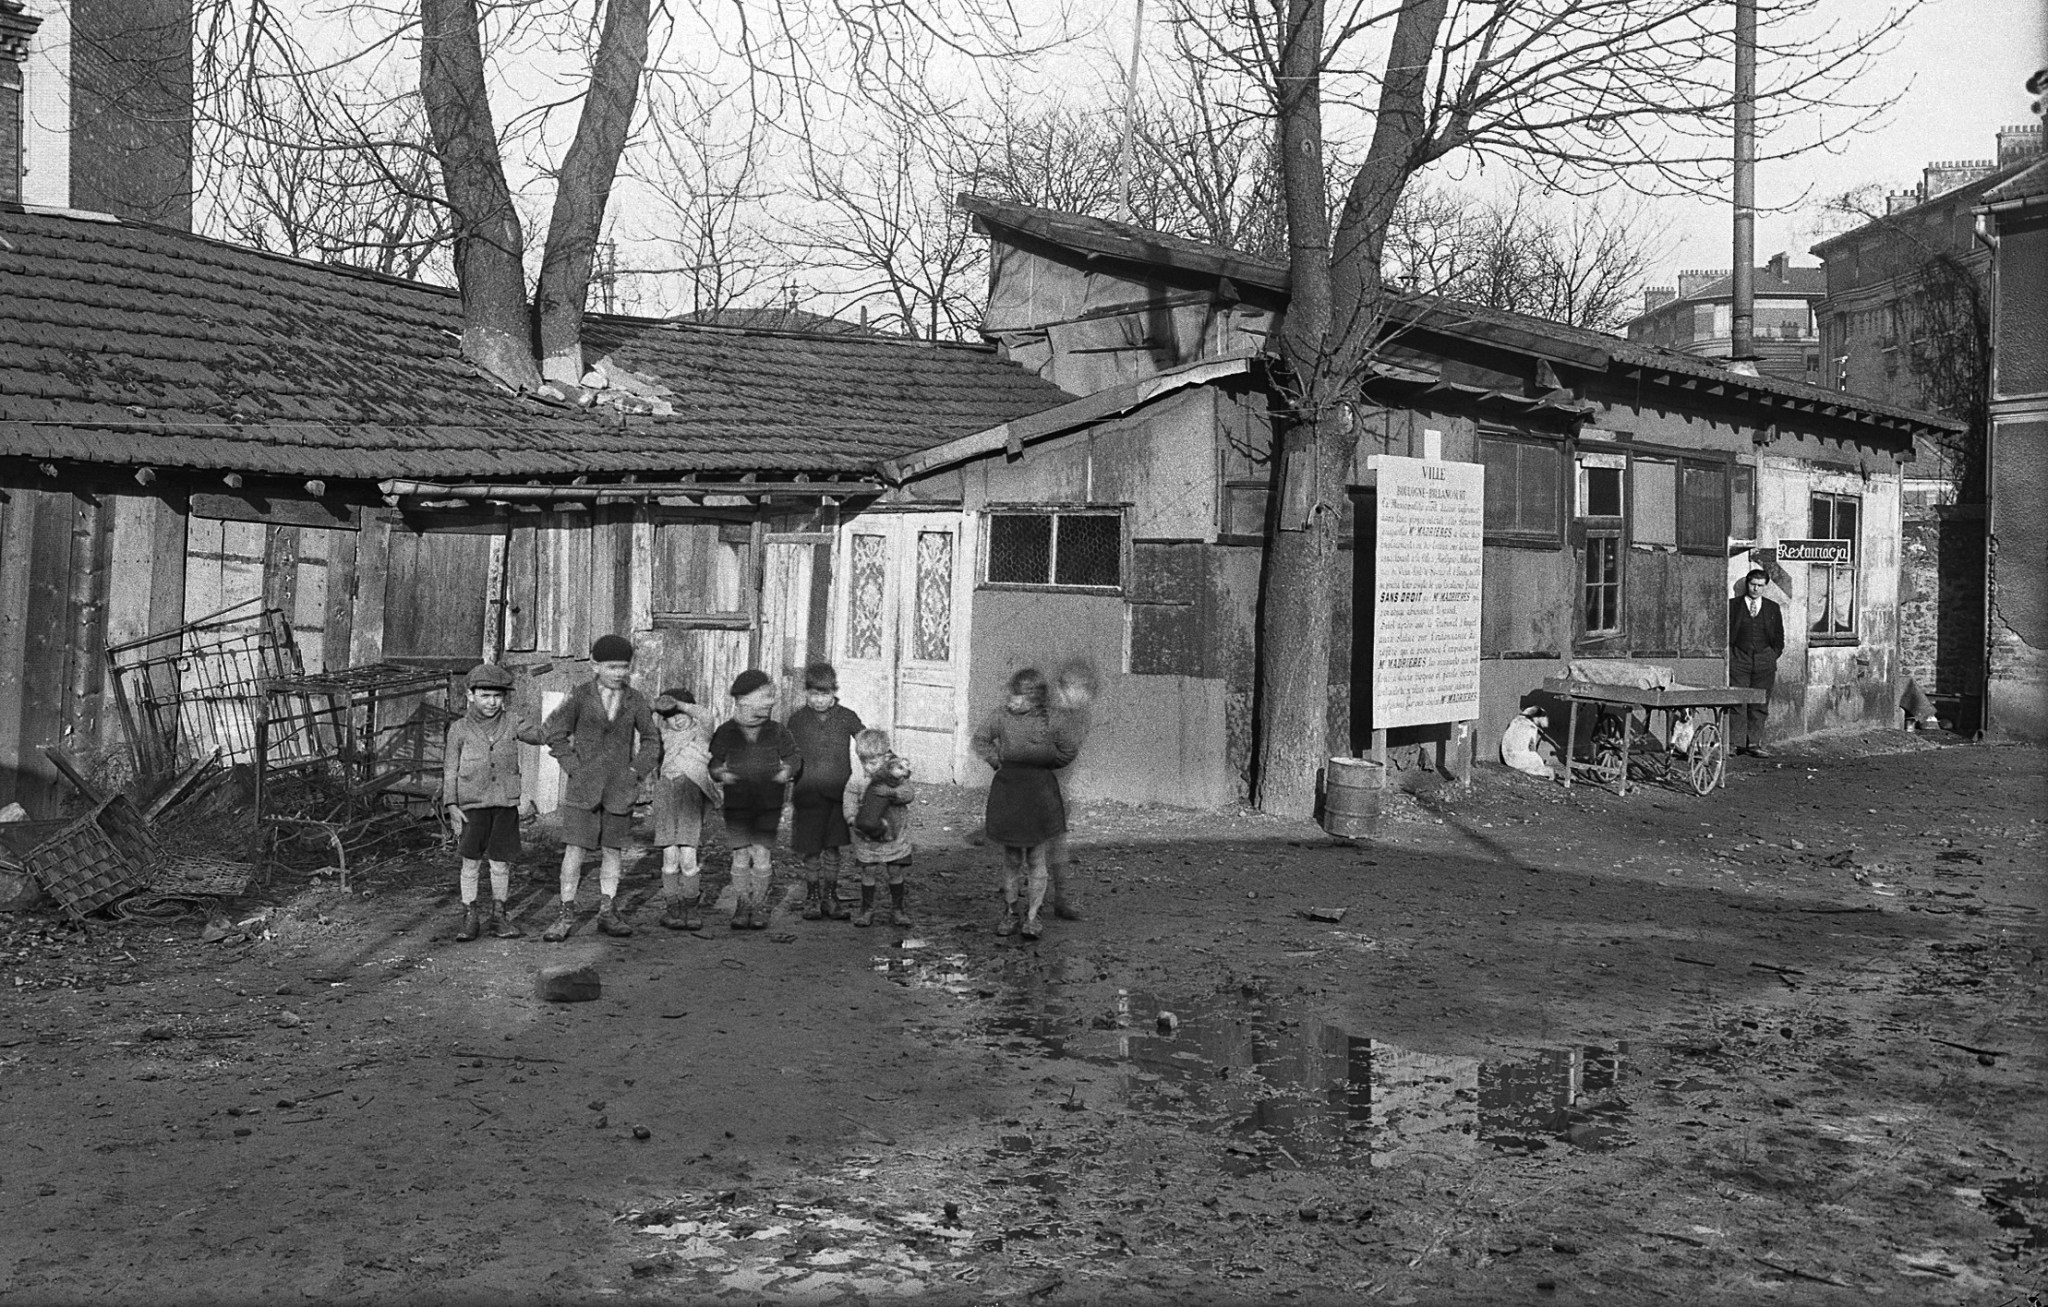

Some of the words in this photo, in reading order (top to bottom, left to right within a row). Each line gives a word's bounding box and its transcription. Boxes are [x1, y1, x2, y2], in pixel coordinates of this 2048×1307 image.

[1422, 466, 1446, 480] VILLE
[1778, 544, 1847, 562] Restauracja
[1380, 592, 1399, 602] SANS
[1401, 592, 1422, 602] DROIT
